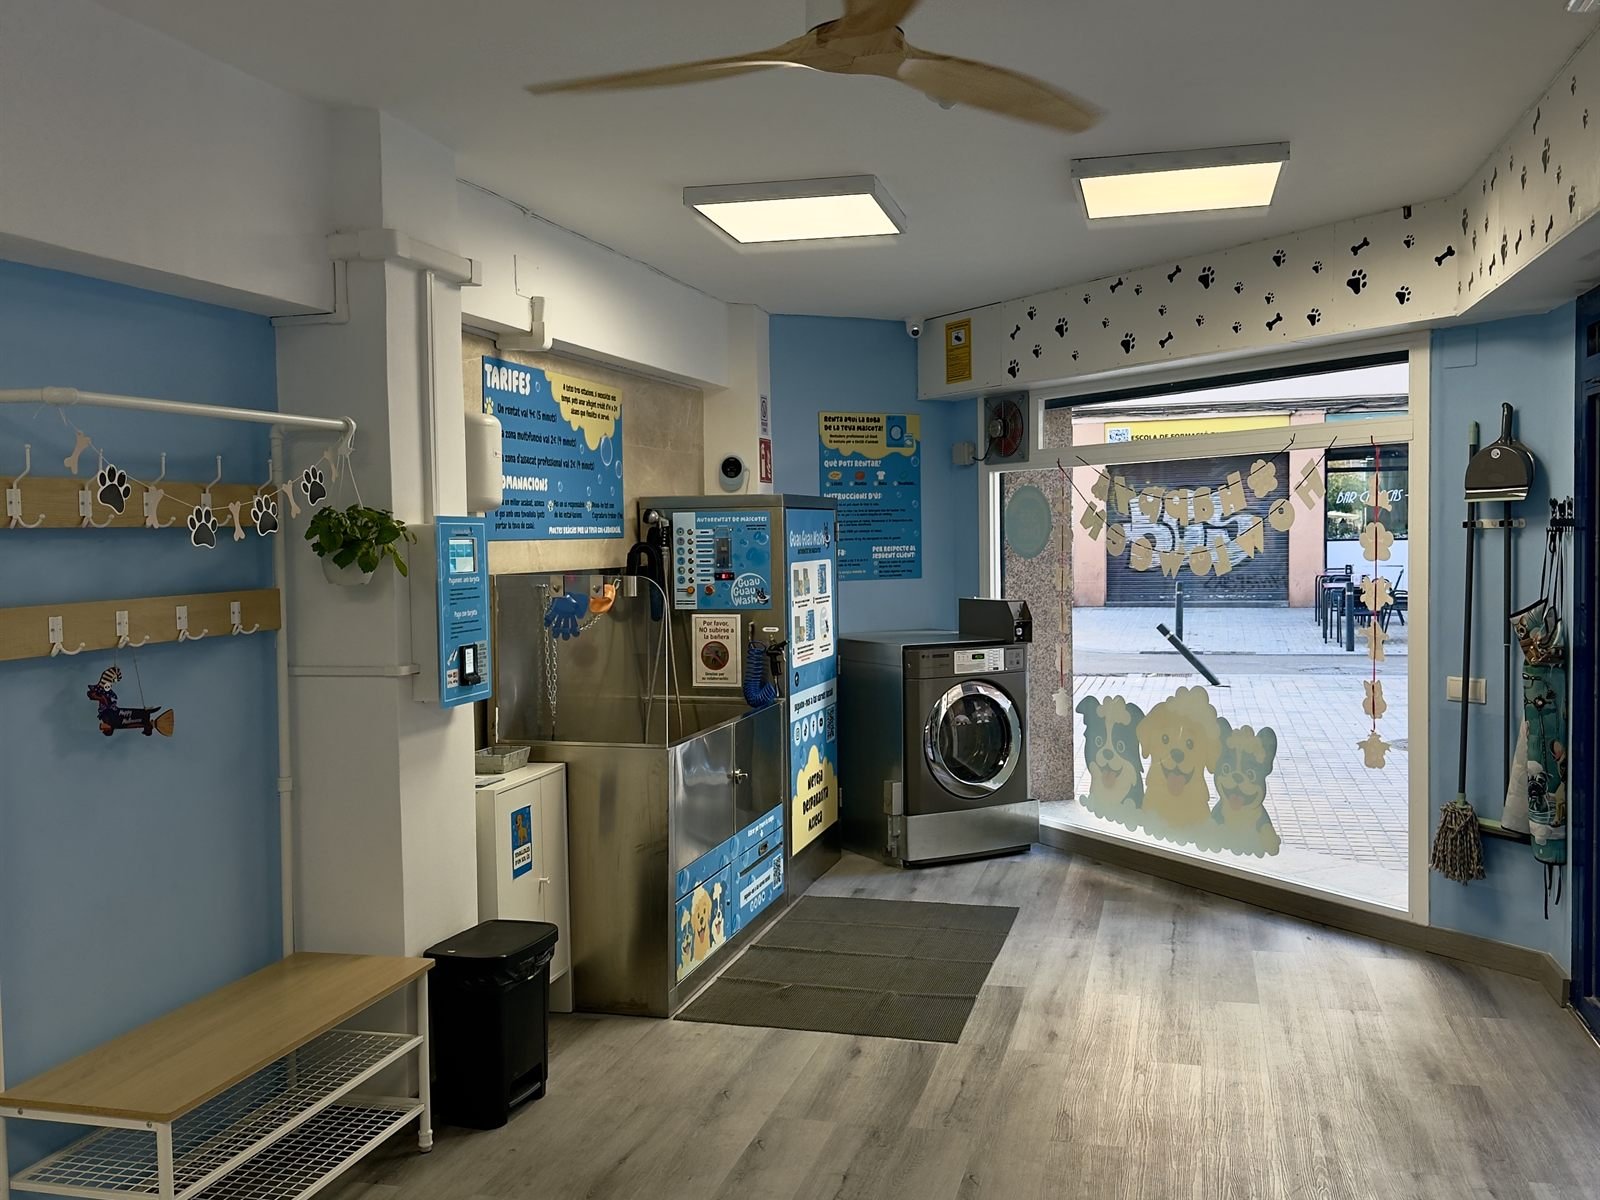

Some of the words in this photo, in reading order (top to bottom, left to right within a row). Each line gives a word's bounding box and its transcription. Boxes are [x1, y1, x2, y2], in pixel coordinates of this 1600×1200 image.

[485, 363, 530, 396] TARIFES
[498, 403, 504, 414] Un
[505, 406, 520, 417] rentat
[521, 408, 529, 418] val
[844, 416, 858, 424] AQUÍ
[506, 431, 516, 440] zona
[505, 454, 516, 463] zona
[824, 459, 838, 467] QUÈ
[502, 475, 548, 492] OMANACIONS
[1336, 490, 1358, 504] BAR
[738, 578, 760, 588] Guau
[733, 586, 756, 597] Guau
[734, 595, 757, 605] Wash
